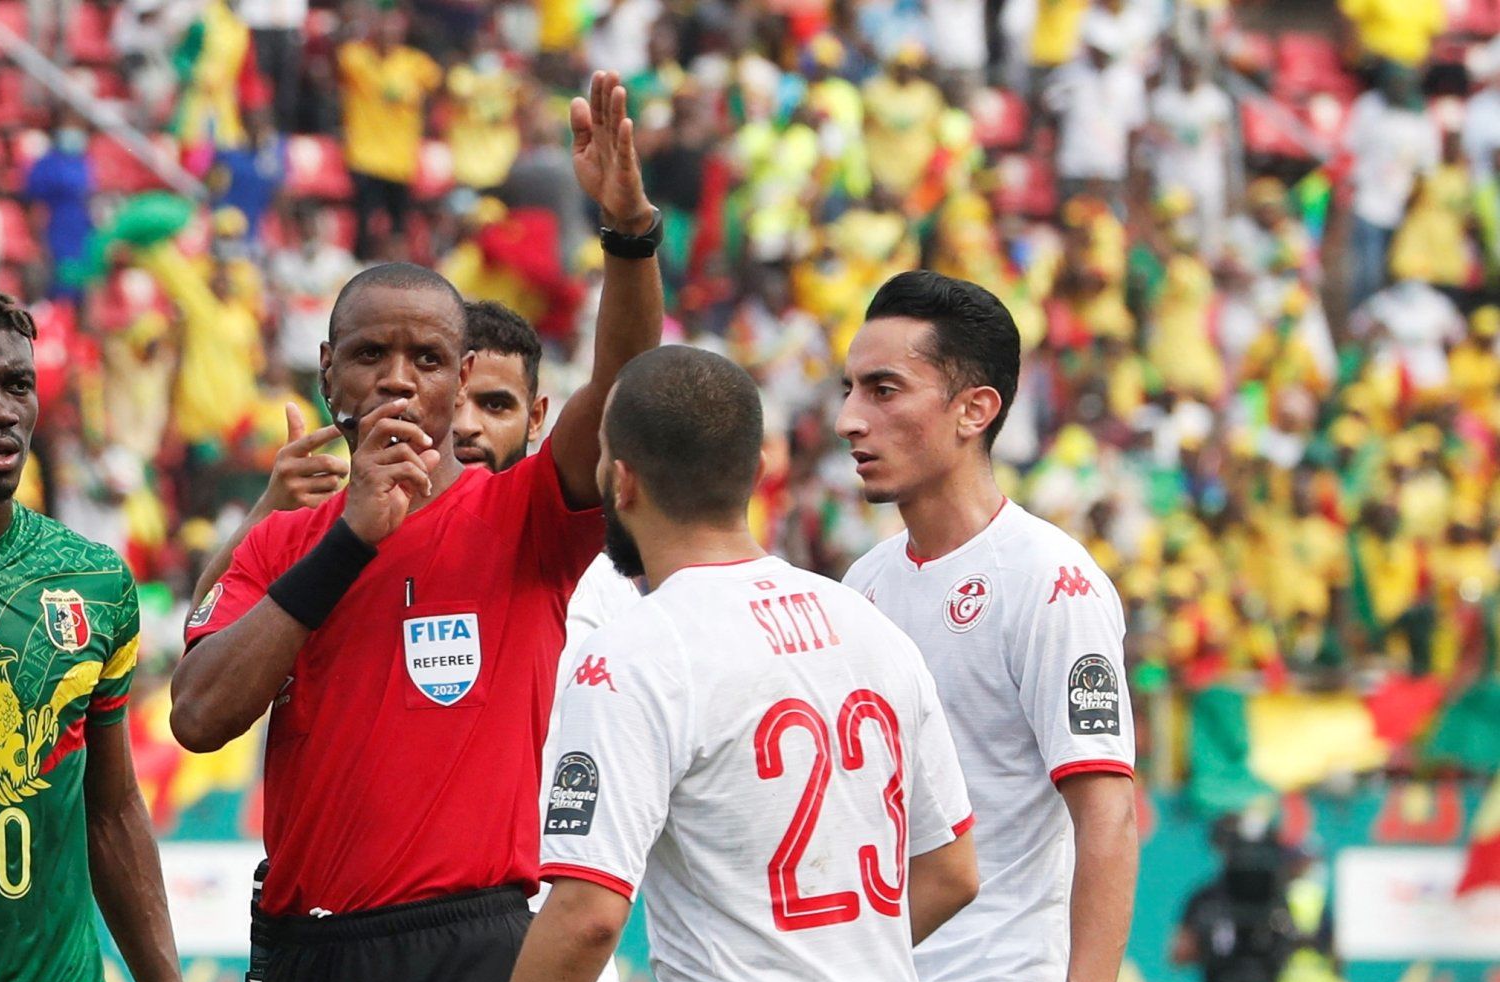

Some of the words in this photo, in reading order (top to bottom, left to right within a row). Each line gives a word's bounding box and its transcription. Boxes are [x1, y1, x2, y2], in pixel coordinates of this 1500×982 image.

[749, 591, 841, 656] SLITI
[410, 619, 471, 644] FIFA
[413, 654, 474, 669] REFEREE
[432, 684, 461, 696] 2022
[1080, 719, 1115, 730] CAF
[753, 688, 906, 932] 23
[548, 819, 581, 829] CAF
